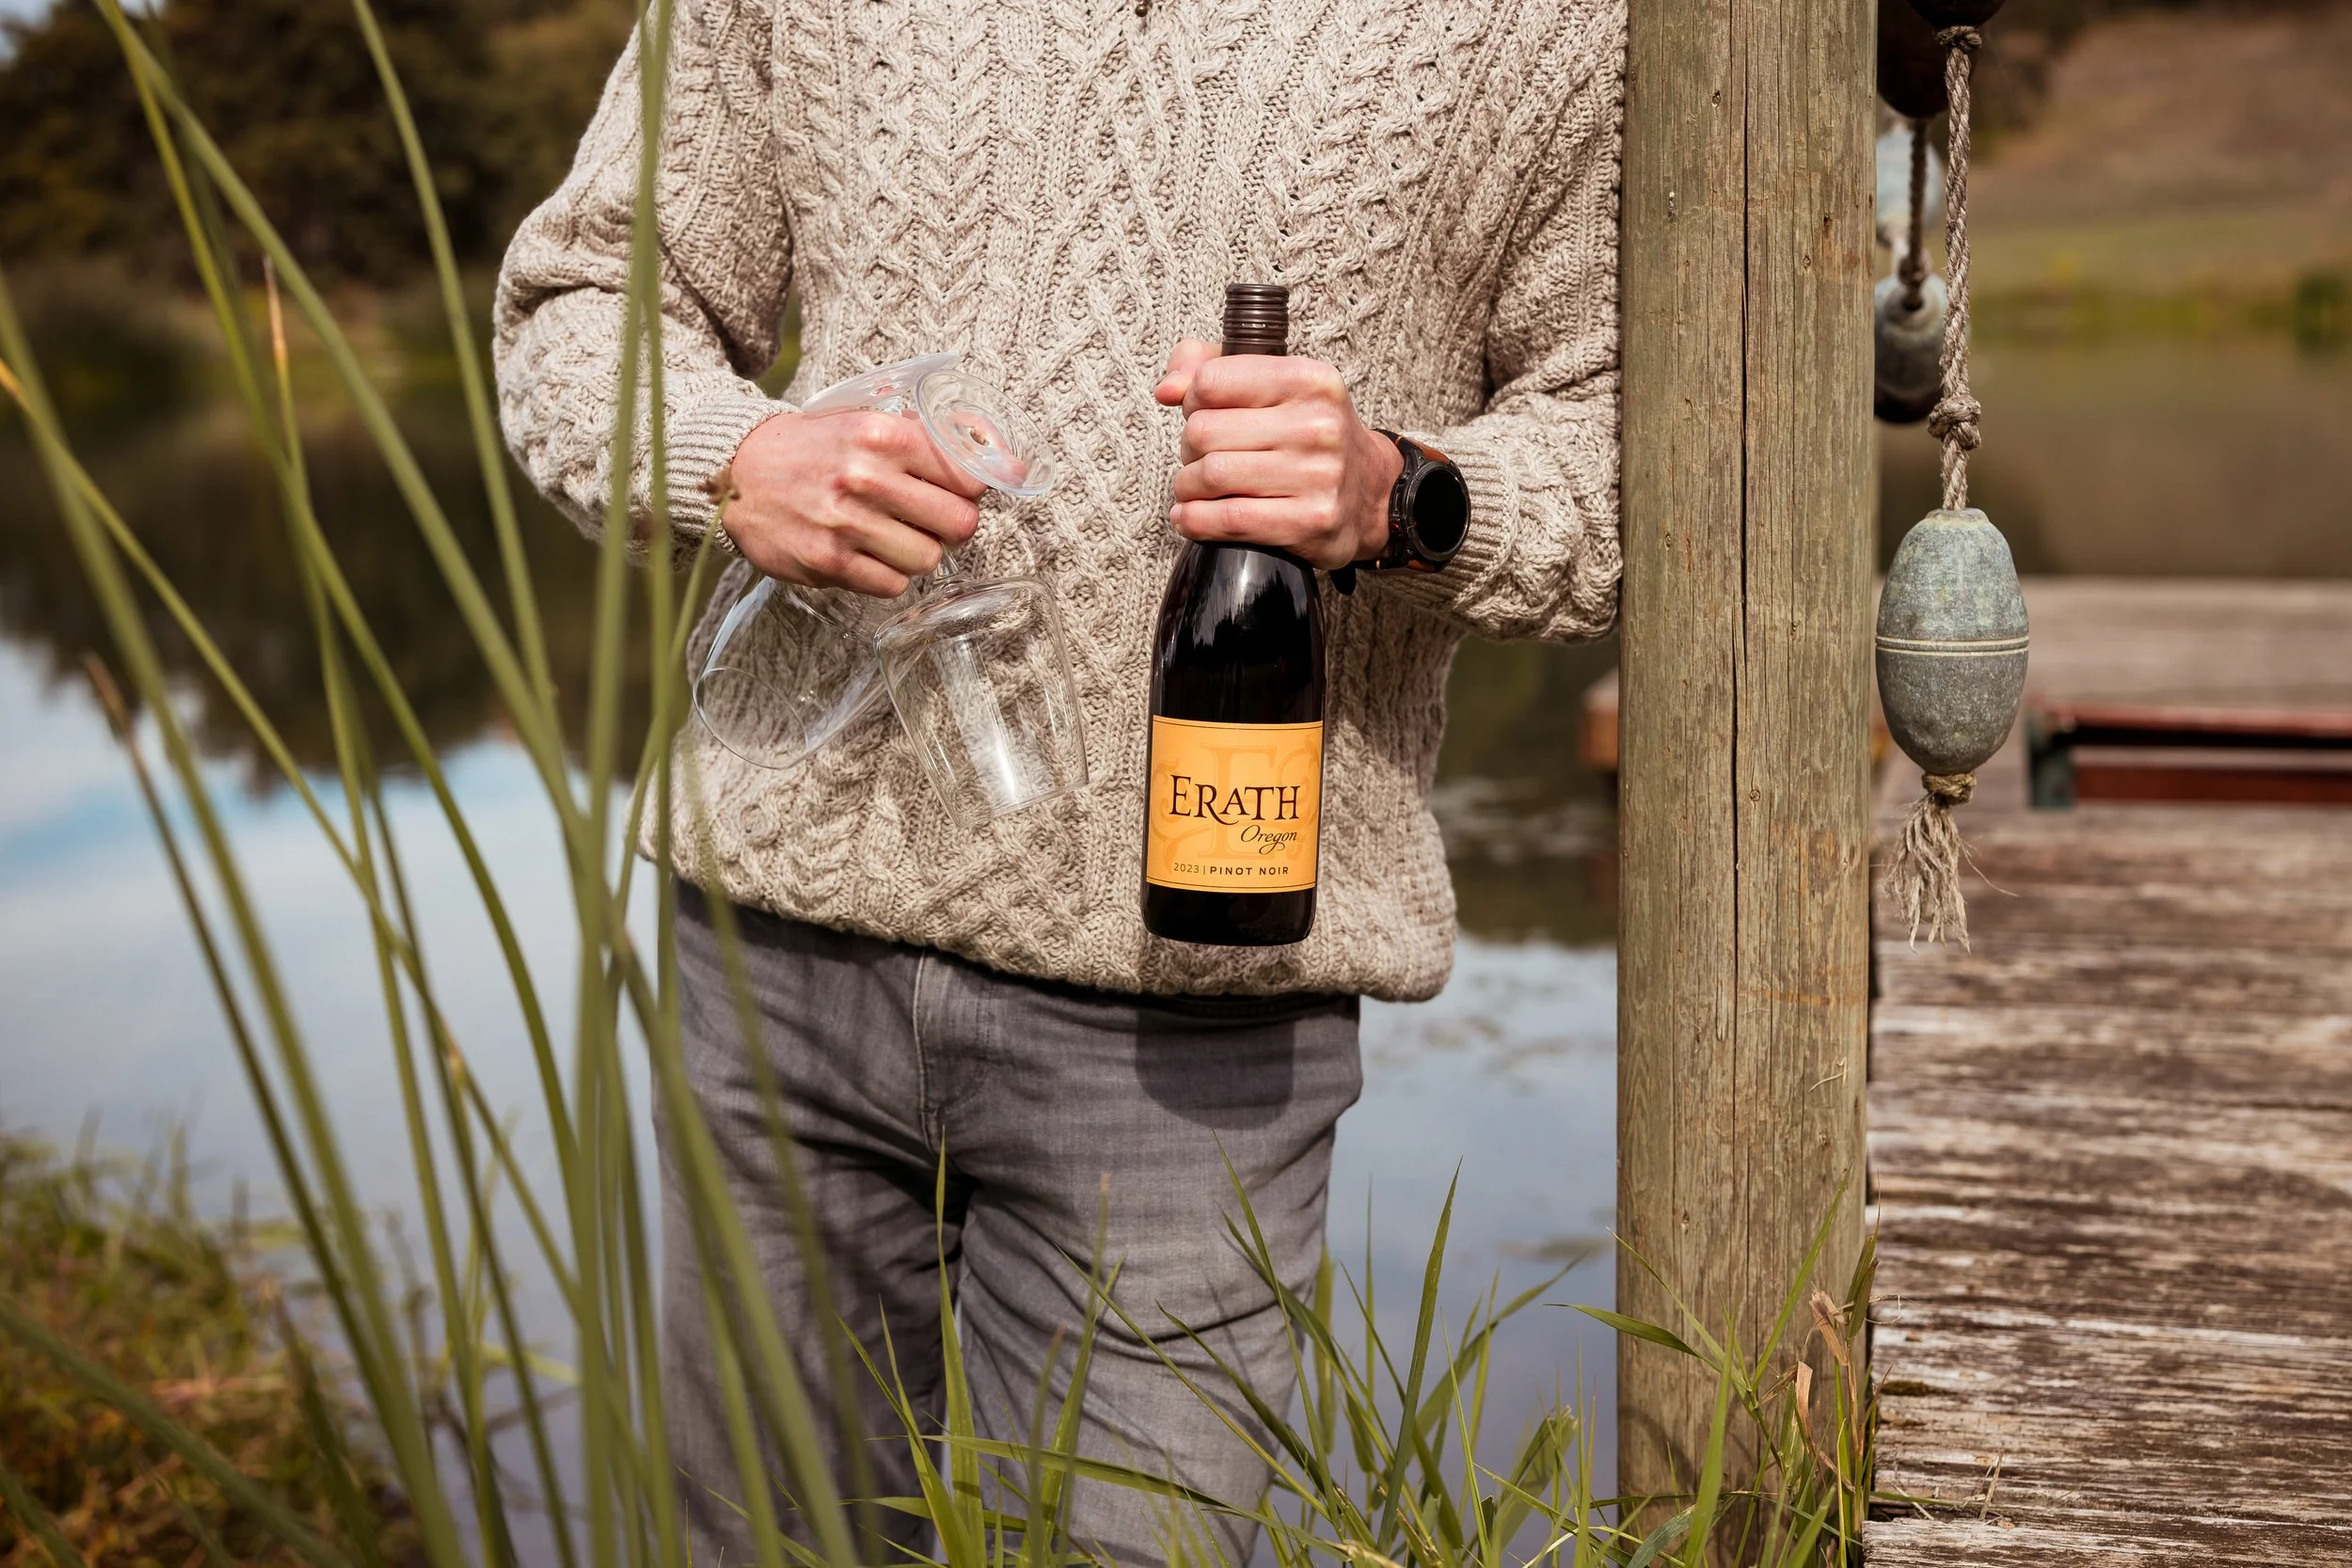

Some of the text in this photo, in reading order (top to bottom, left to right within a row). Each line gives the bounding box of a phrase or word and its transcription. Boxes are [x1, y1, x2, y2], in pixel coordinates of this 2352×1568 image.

[1168, 774, 1301, 825] ERATH
[1240, 824, 1297, 855] Oregon
[1173, 863, 1289, 876] 2023 PINOT NOIR
